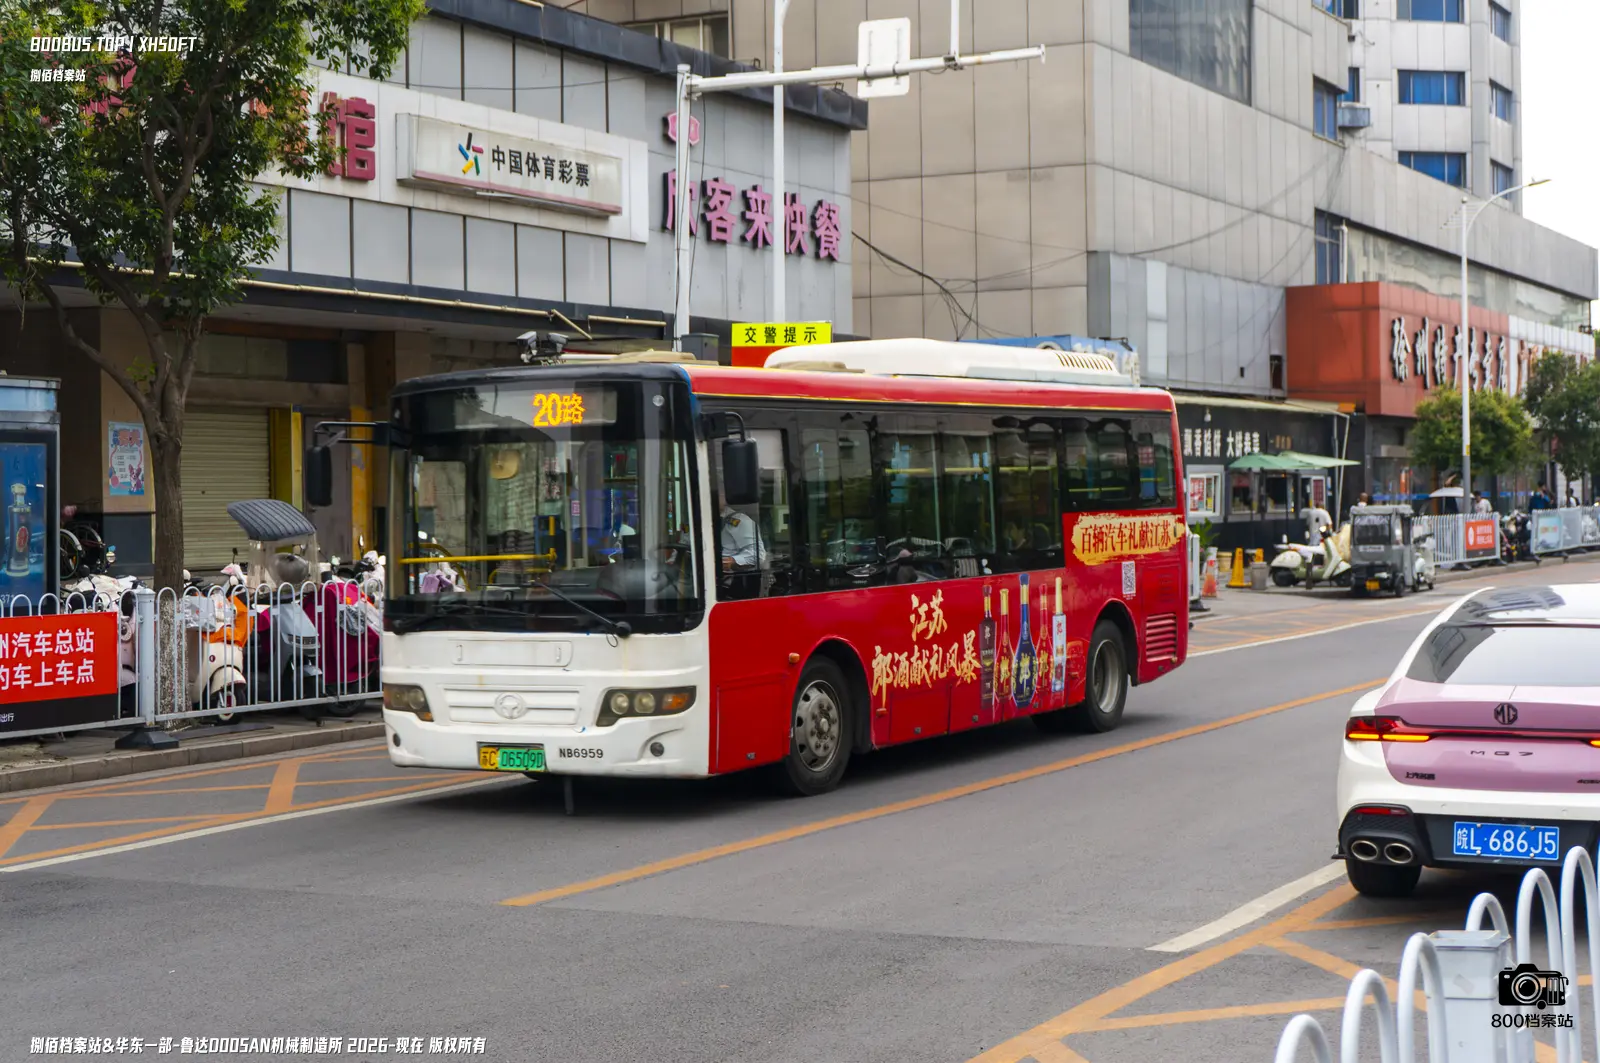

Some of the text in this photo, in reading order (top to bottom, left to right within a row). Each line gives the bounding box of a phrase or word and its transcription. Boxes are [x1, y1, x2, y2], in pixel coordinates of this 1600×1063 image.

[491, 145, 590, 187] 中国体育彩票
[745, 326, 817, 344] 交警提示
[532, 392, 586, 427] 20路
[1081, 520, 1171, 554] 百辆汽车礼献江苏
[910, 588, 948, 642] 江苏
[872, 630, 982, 708] 郎酒献礼风暴
[0, 713, 14, 723] 出行
[1494, 703, 1518, 725] MG
[559, 748, 604, 759] NB6959
